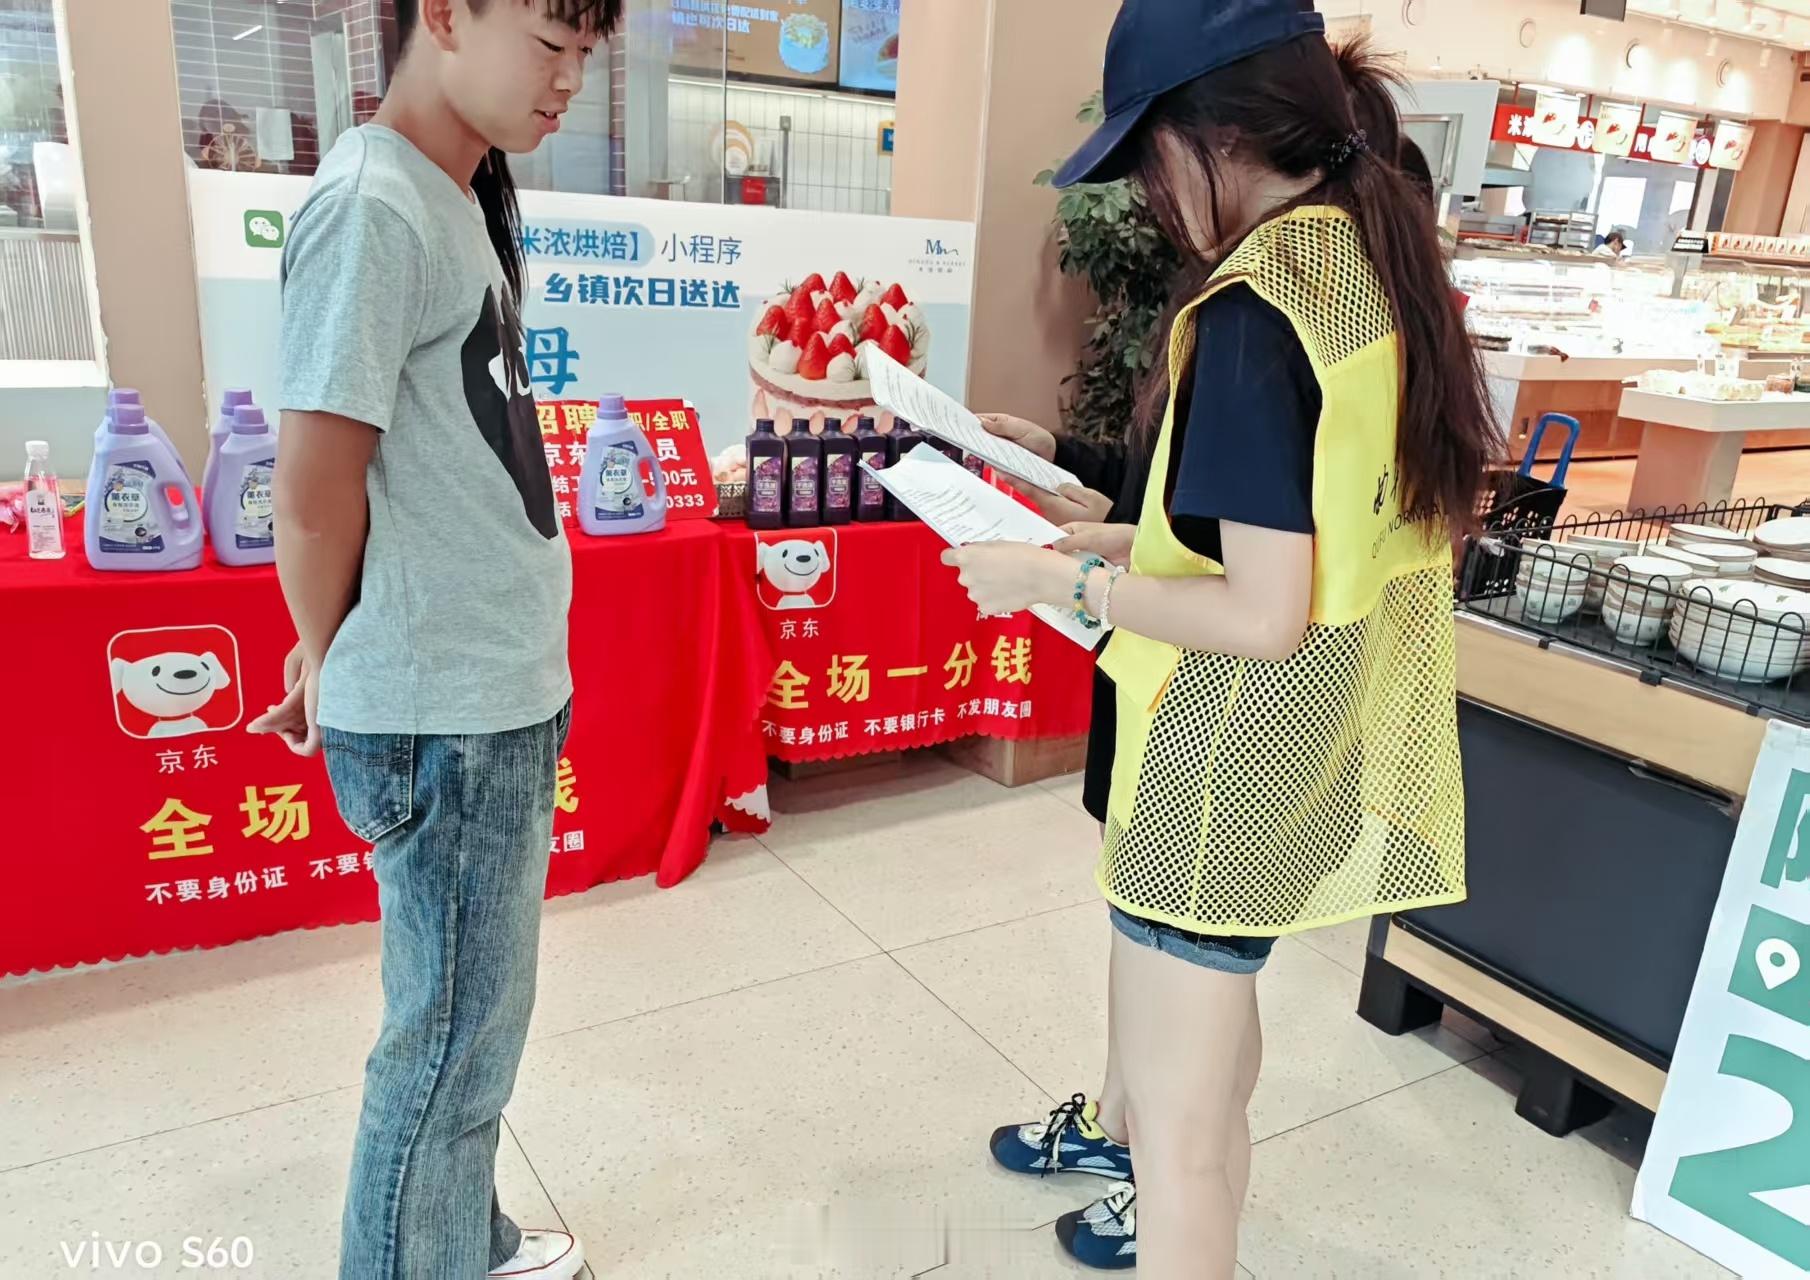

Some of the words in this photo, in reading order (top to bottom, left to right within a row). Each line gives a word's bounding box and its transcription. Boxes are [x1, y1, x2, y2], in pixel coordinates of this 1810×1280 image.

[661, 233, 743, 265] 小程序
[544, 272, 741, 309] 乡镇次日送达
[526, 326, 580, 395] 母
[658, 438, 681, 461] 员
[780, 617, 820, 640] 京东
[768, 634, 1033, 710] 全场一分钱
[761, 719, 849, 746] 不要身份证
[863, 707, 946, 737] 不要银行卡
[956, 697, 1032, 720] 不发朋友圈
[155, 743, 219, 775] 京东
[139, 783, 312, 861] 全场
[144, 865, 289, 905] 不要身份证
